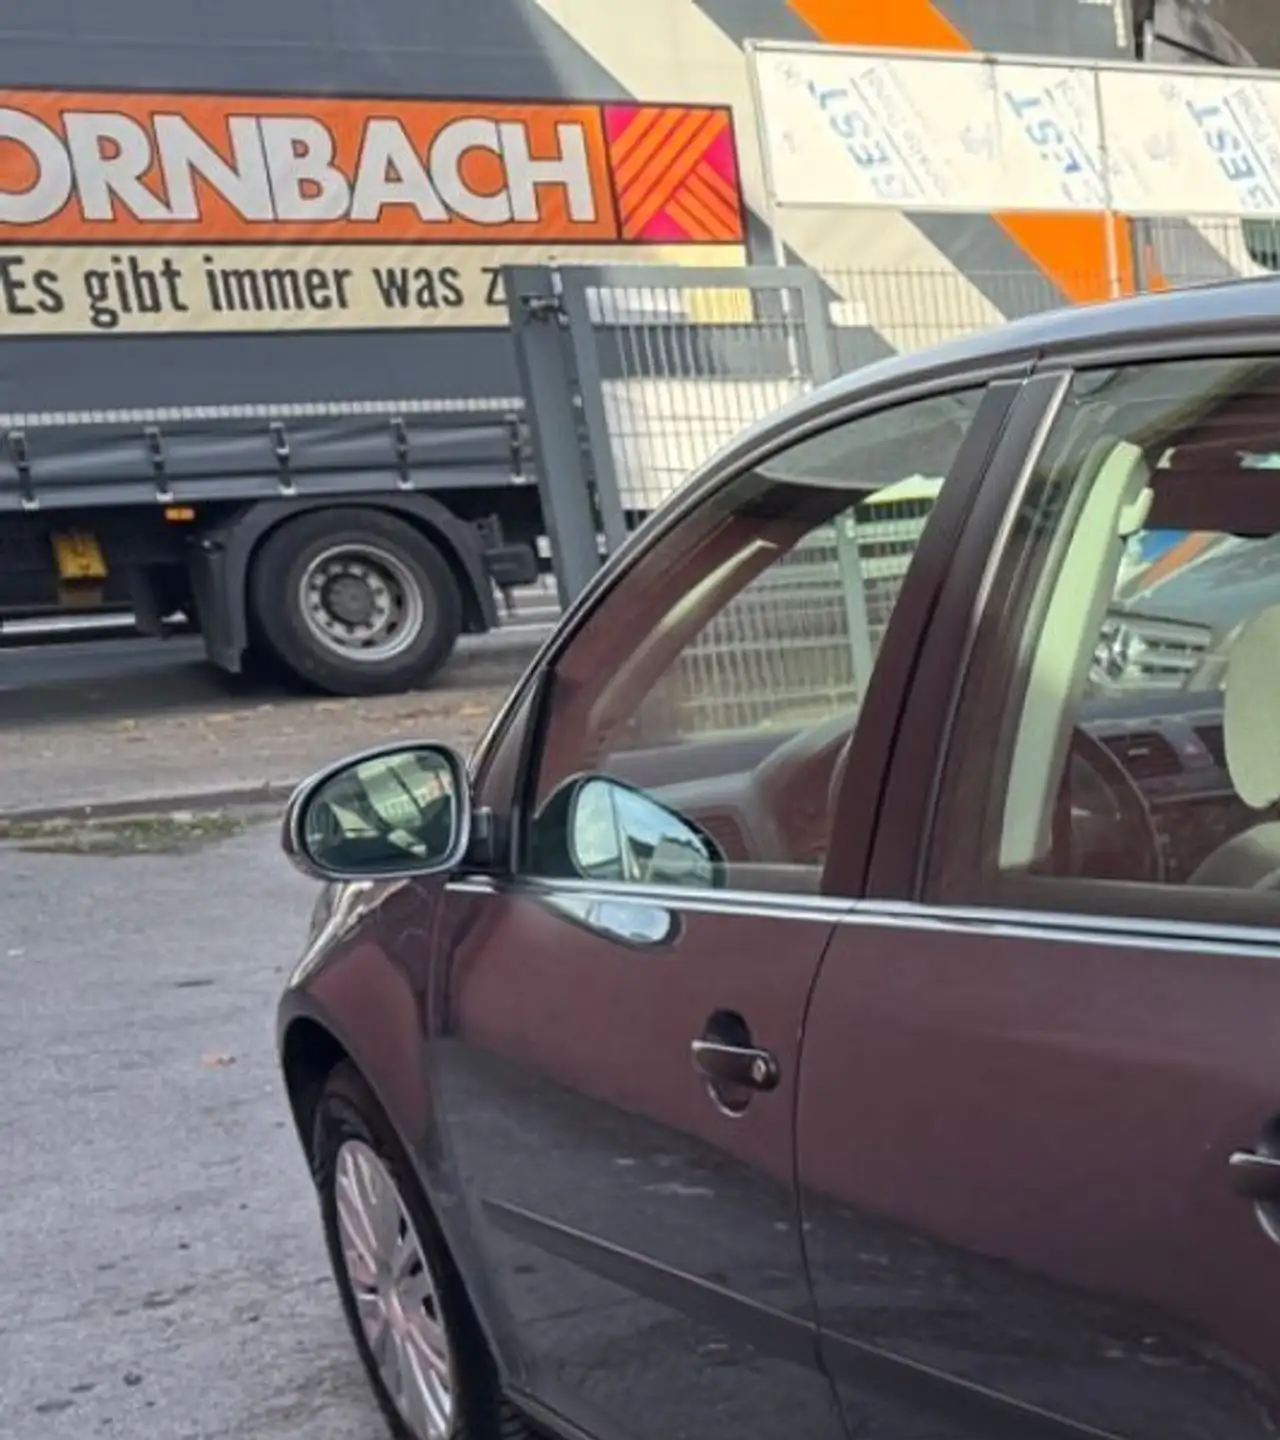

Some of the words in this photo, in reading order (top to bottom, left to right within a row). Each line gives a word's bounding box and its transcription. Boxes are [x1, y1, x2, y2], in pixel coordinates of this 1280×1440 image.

[0, 107, 598, 225] ORNBACH
[0, 255, 65, 314] Es
[84, 255, 188, 329] gibt
[203, 255, 352, 311] immer
[372, 266, 464, 309] was
